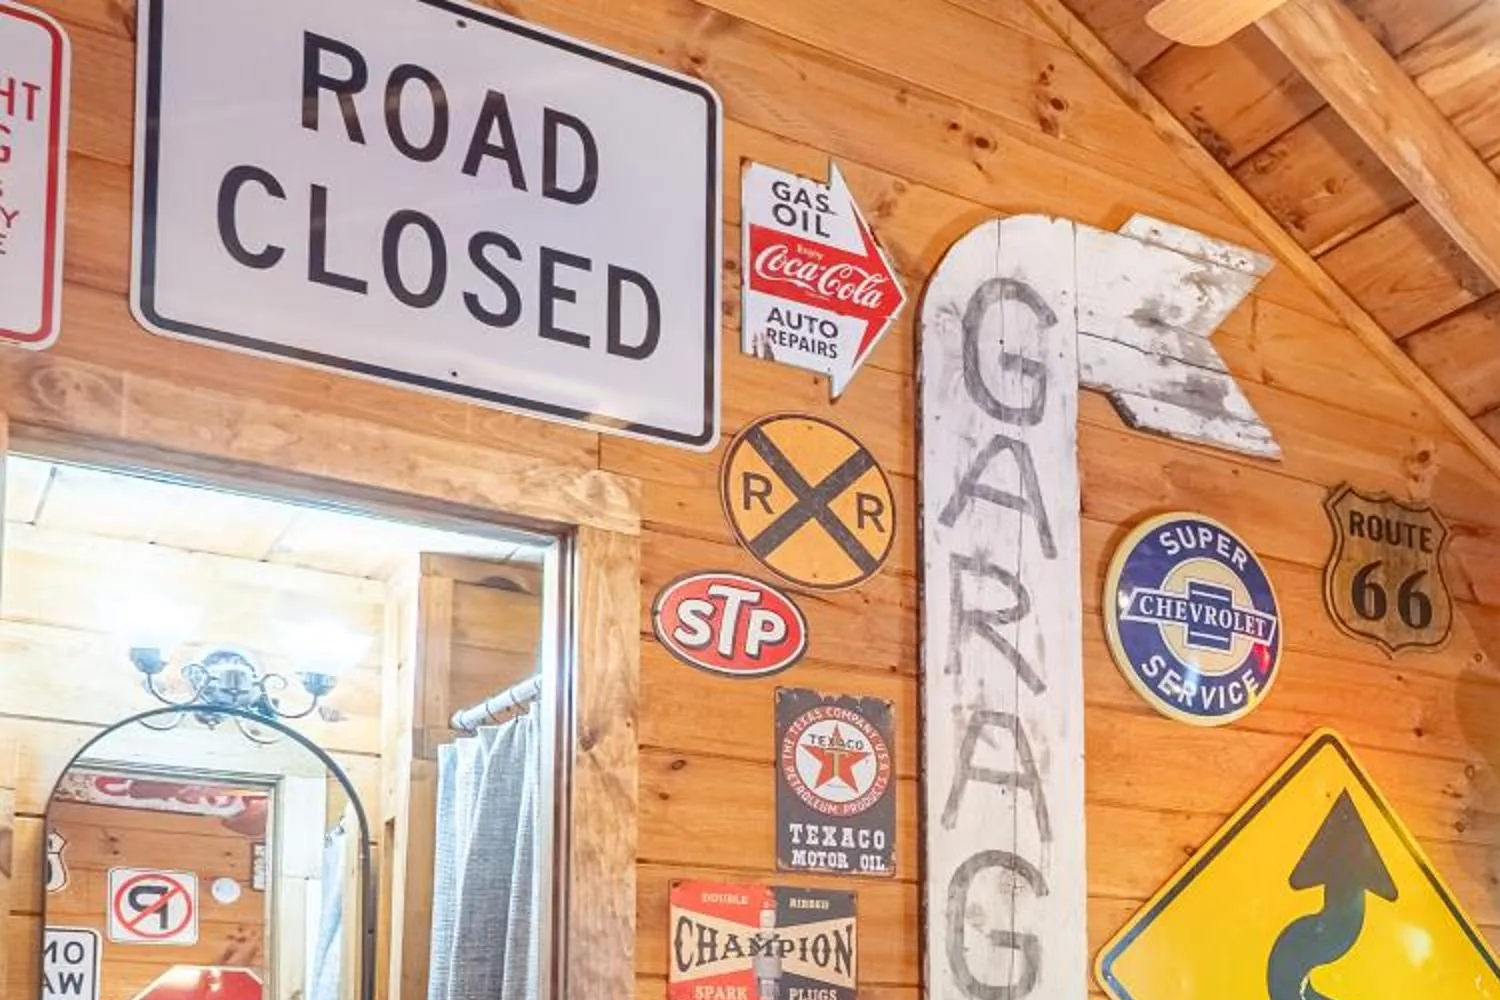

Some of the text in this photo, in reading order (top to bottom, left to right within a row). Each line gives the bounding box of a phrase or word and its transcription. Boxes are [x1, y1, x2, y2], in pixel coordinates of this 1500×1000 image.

[302, 31, 599, 205] ROAD
[772, 181, 829, 213] GAS
[772, 204, 831, 238] OIL
[217, 165, 661, 361] CLOSED
[755, 245, 888, 308] Coca-Cola
[766, 328, 838, 359] REPAIRS
[767, 307, 839, 339] AUTO
[742, 471, 885, 533] R R
[1159, 525, 1249, 571] SUPER
[1350, 510, 1433, 554] ROUTE
[1139, 595, 1266, 637] CHEVROLET
[1352, 560, 1432, 629] 66
[673, 584, 787, 658] STP
[1141, 655, 1260, 710] SERVICE
[808, 734, 864, 750] TEXACO
[789, 823, 885, 850] TEXACO
[791, 850, 885, 871] MOTOR OIL
[674, 915, 853, 978] CHAMPION
[695, 985, 748, 1000] SPARK
